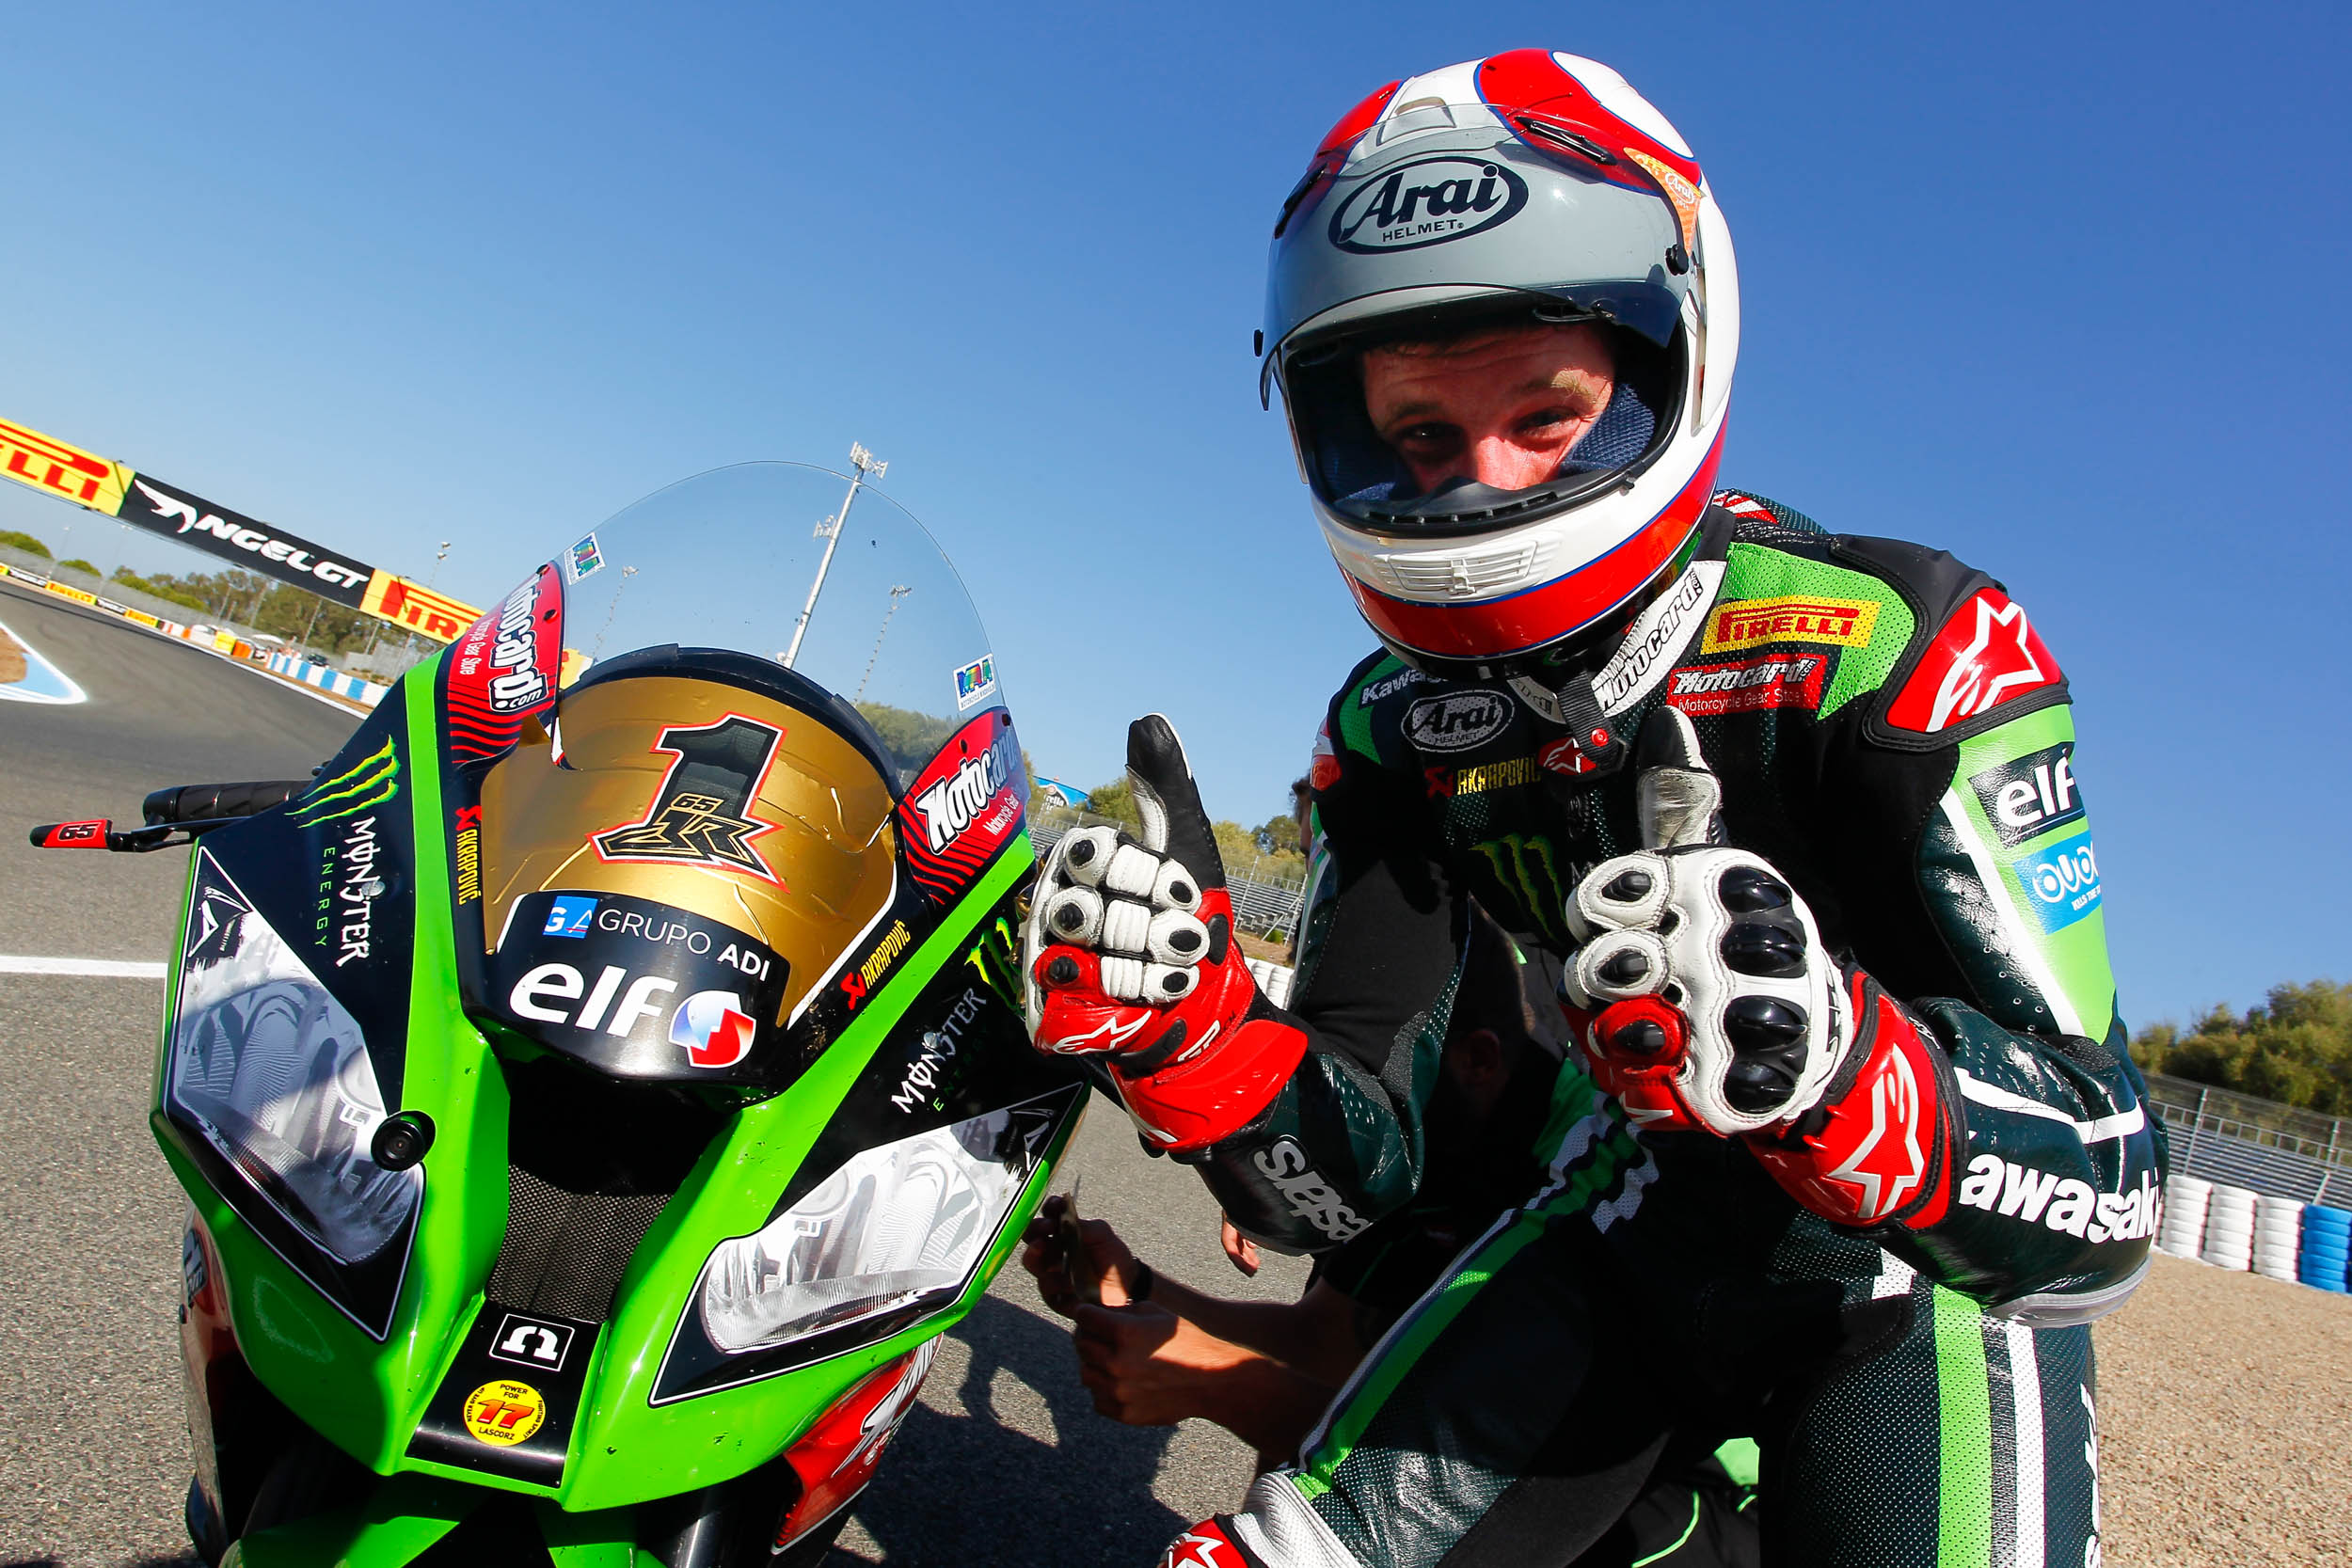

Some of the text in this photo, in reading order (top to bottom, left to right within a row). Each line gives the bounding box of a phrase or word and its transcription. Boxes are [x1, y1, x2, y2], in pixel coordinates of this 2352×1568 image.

[1340, 165, 1502, 242] Arai
[1716, 603, 1860, 643] PIRELLI
[1411, 694, 1500, 738] Arai
[1678, 692, 1740, 713] Motorcycle
[1744, 690, 1770, 705] Gear
[1435, 730, 1479, 745] HELMET
[670, 792, 724, 814] 65
[1996, 748, 2075, 827] elf
[58, 822, 99, 840] 65
[315, 846, 336, 947] ENERGY
[598, 909, 771, 982] GRUPO ADI
[508, 962, 679, 1038] elf
[1958, 1154, 2159, 1243] awasaki
[477, 1386, 485, 1395] UP
[500, 1383, 529, 1395] POWER
[503, 1391, 519, 1400] FOR
[477, 1398, 535, 1430] 17
[478, 1426, 516, 1441] LASCORZ
